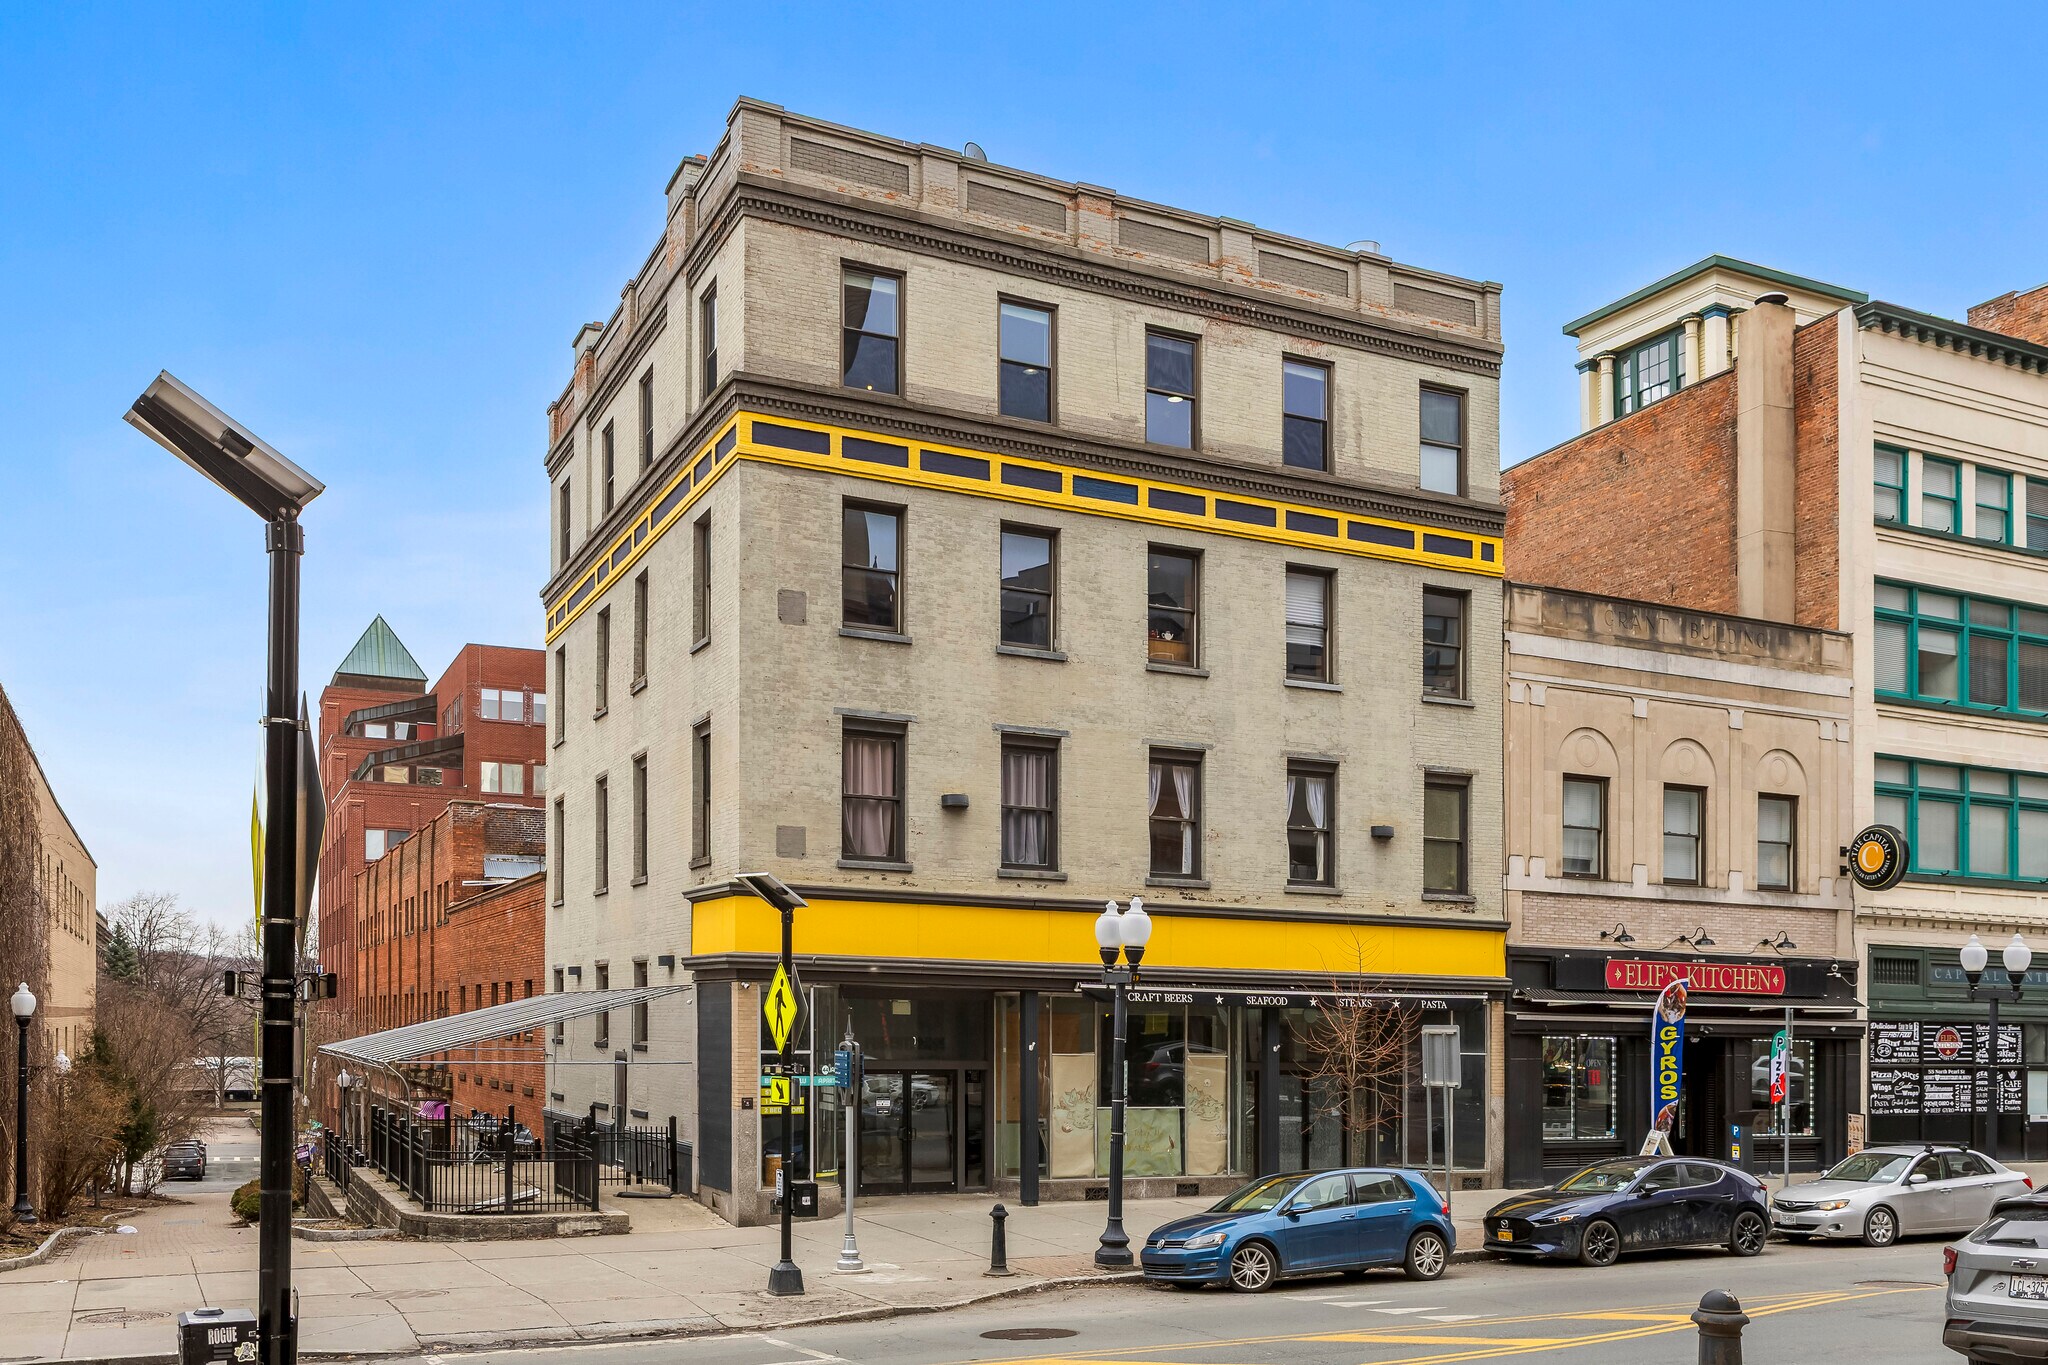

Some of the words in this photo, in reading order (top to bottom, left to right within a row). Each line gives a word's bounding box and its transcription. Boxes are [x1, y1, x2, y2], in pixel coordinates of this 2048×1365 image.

[1604, 610, 1668, 634] GRANT
[1690, 622, 1765, 648] BUILDING
[1851, 839, 1863, 856] THE
[1863, 834, 1890, 854] CAPITAL
[1862, 846, 1878, 868] C
[1625, 963, 1679, 986] ELIF'S
[1686, 966, 1770, 990] KITCHEN
[1934, 968, 1999, 981] CAPAL
[1127, 992, 1161, 1002] CRAFT
[1164, 994, 1193, 1003] BEERS
[1246, 996, 1288, 1006] SEAFOOD
[1340, 998, 1373, 1008] STEAKS
[1421, 1000, 1447, 1009] PASTA
[1660, 1026, 1678, 1100] GYROS
[1774, 1038, 1784, 1096] PIZZA
[1872, 1083, 1892, 1092] Wings
[208, 1327, 237, 1344] ROGUE
